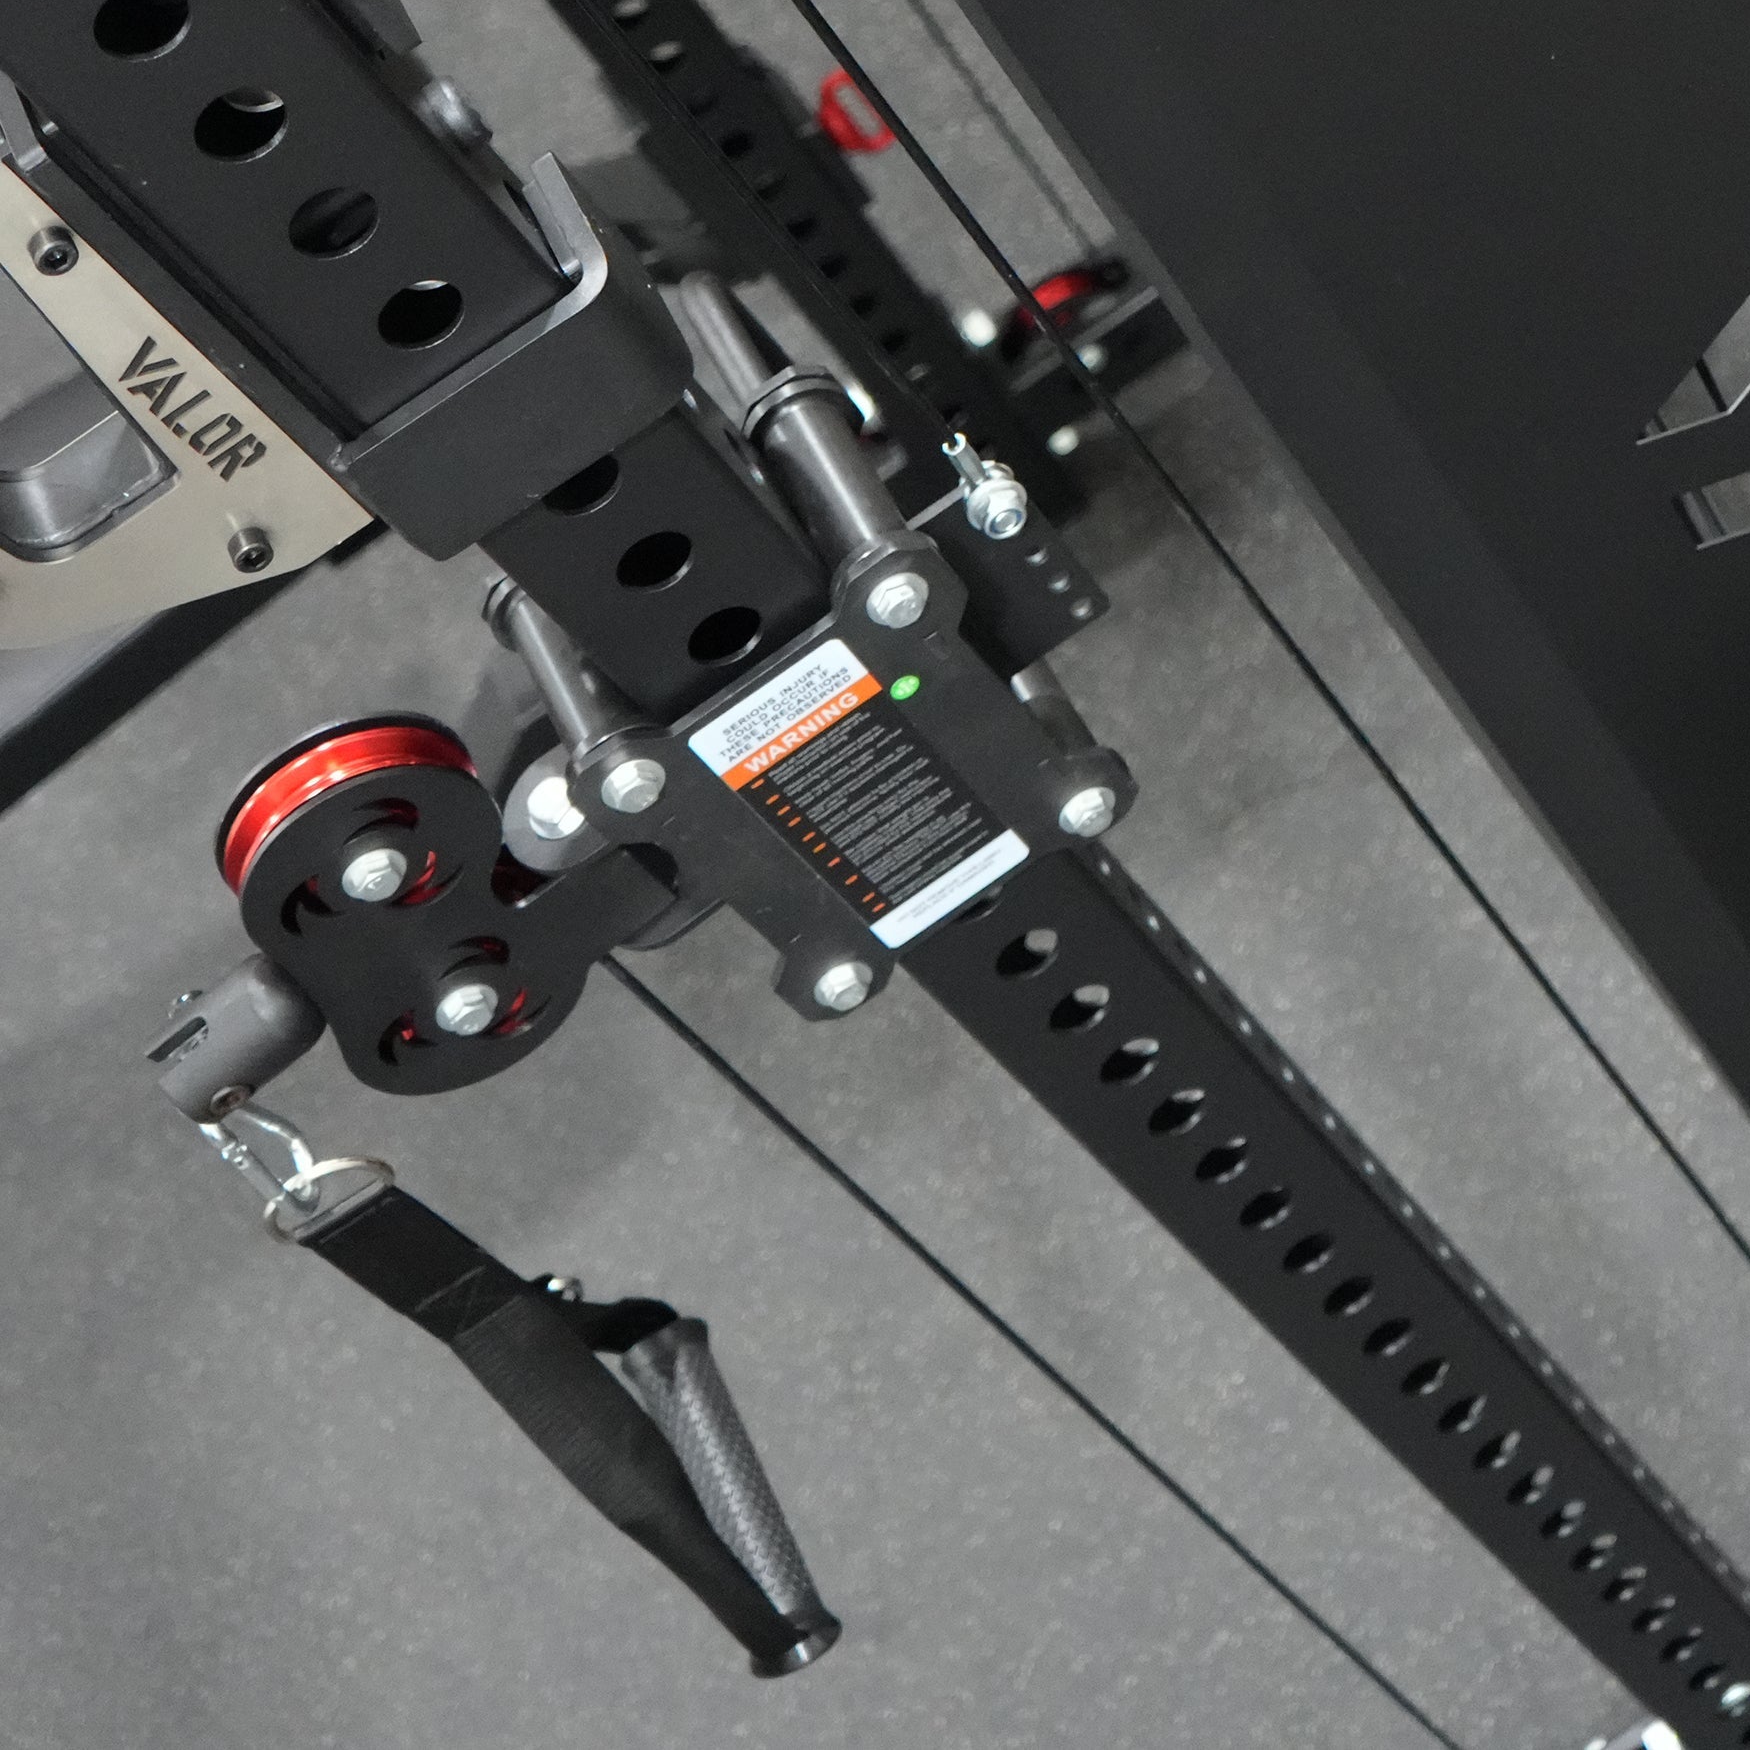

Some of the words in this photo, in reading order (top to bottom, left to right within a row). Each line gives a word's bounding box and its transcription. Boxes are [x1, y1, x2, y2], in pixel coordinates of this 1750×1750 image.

[118, 335, 268, 483] VALOR
[718, 727, 760, 758] THESE
[762, 665, 849, 728] PRECAUTIONS
[720, 695, 777, 737] SERIOUS
[777, 663, 824, 697] INJURY
[724, 711, 769, 744] COULD
[770, 678, 816, 712] OCCUR
[817, 667, 832, 680] IF
[725, 741, 753, 763] ARE
[755, 721, 783, 742] NOT
[784, 672, 853, 722] OBSERVED
[744, 691, 860, 774] WARNING
